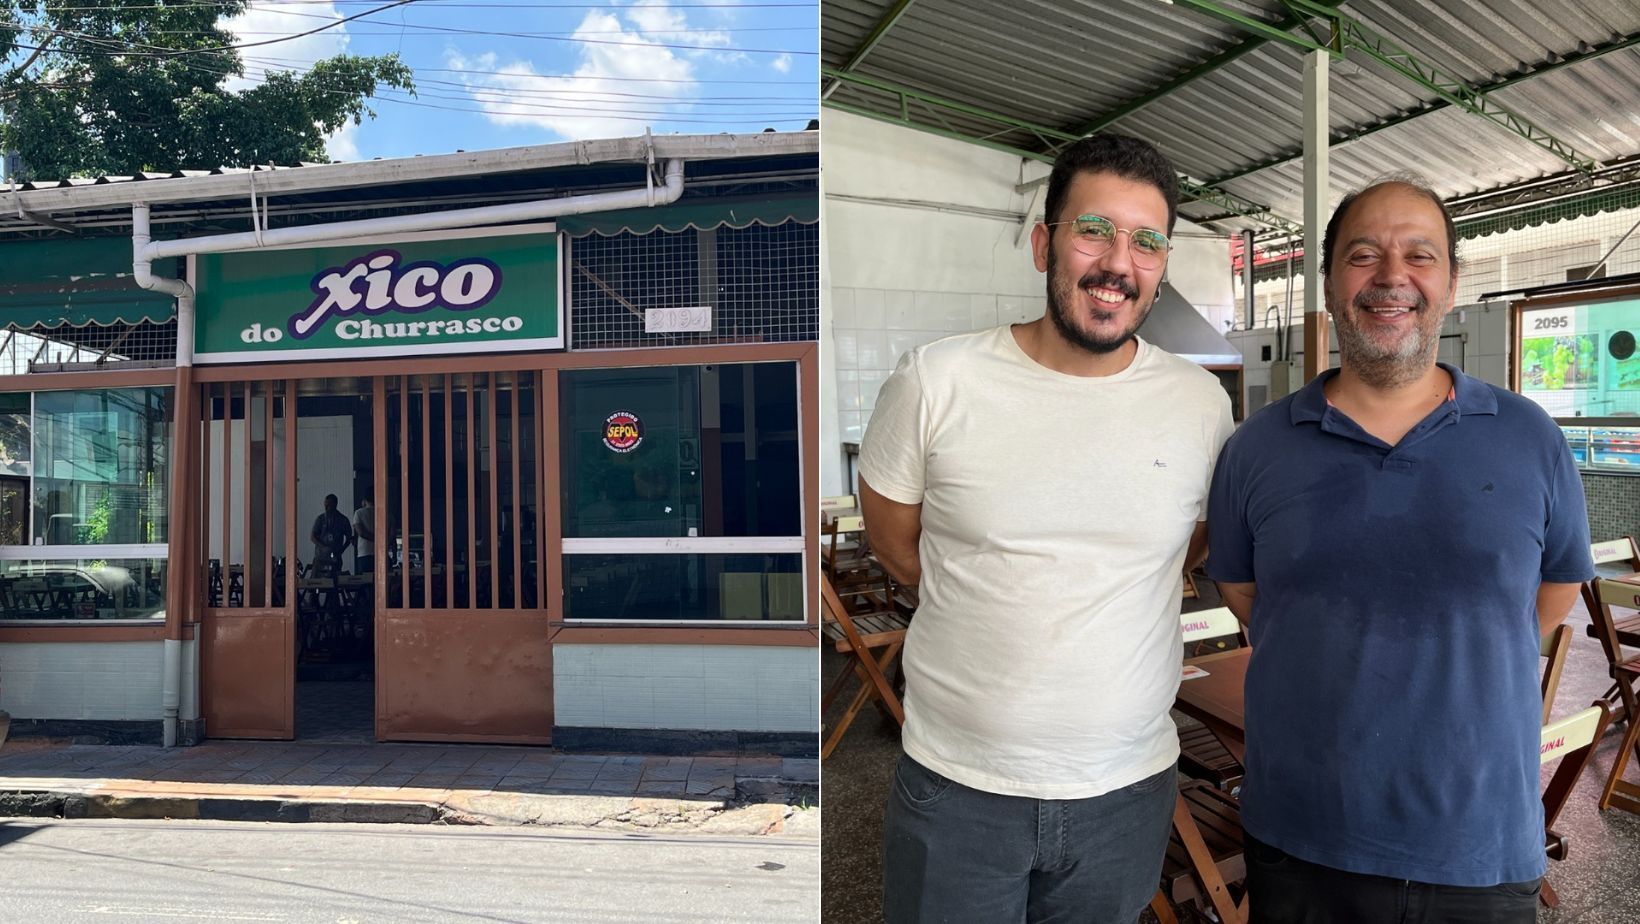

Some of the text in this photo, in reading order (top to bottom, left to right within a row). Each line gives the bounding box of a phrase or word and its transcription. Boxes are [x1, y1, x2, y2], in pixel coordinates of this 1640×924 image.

[240, 315, 524, 343] do Churrasco
[1534, 316, 1568, 330] 2095
[606, 411, 638, 423] PROTEGIDO
[607, 426, 638, 438] SEPOL
[1540, 736, 1565, 754] GINAL
